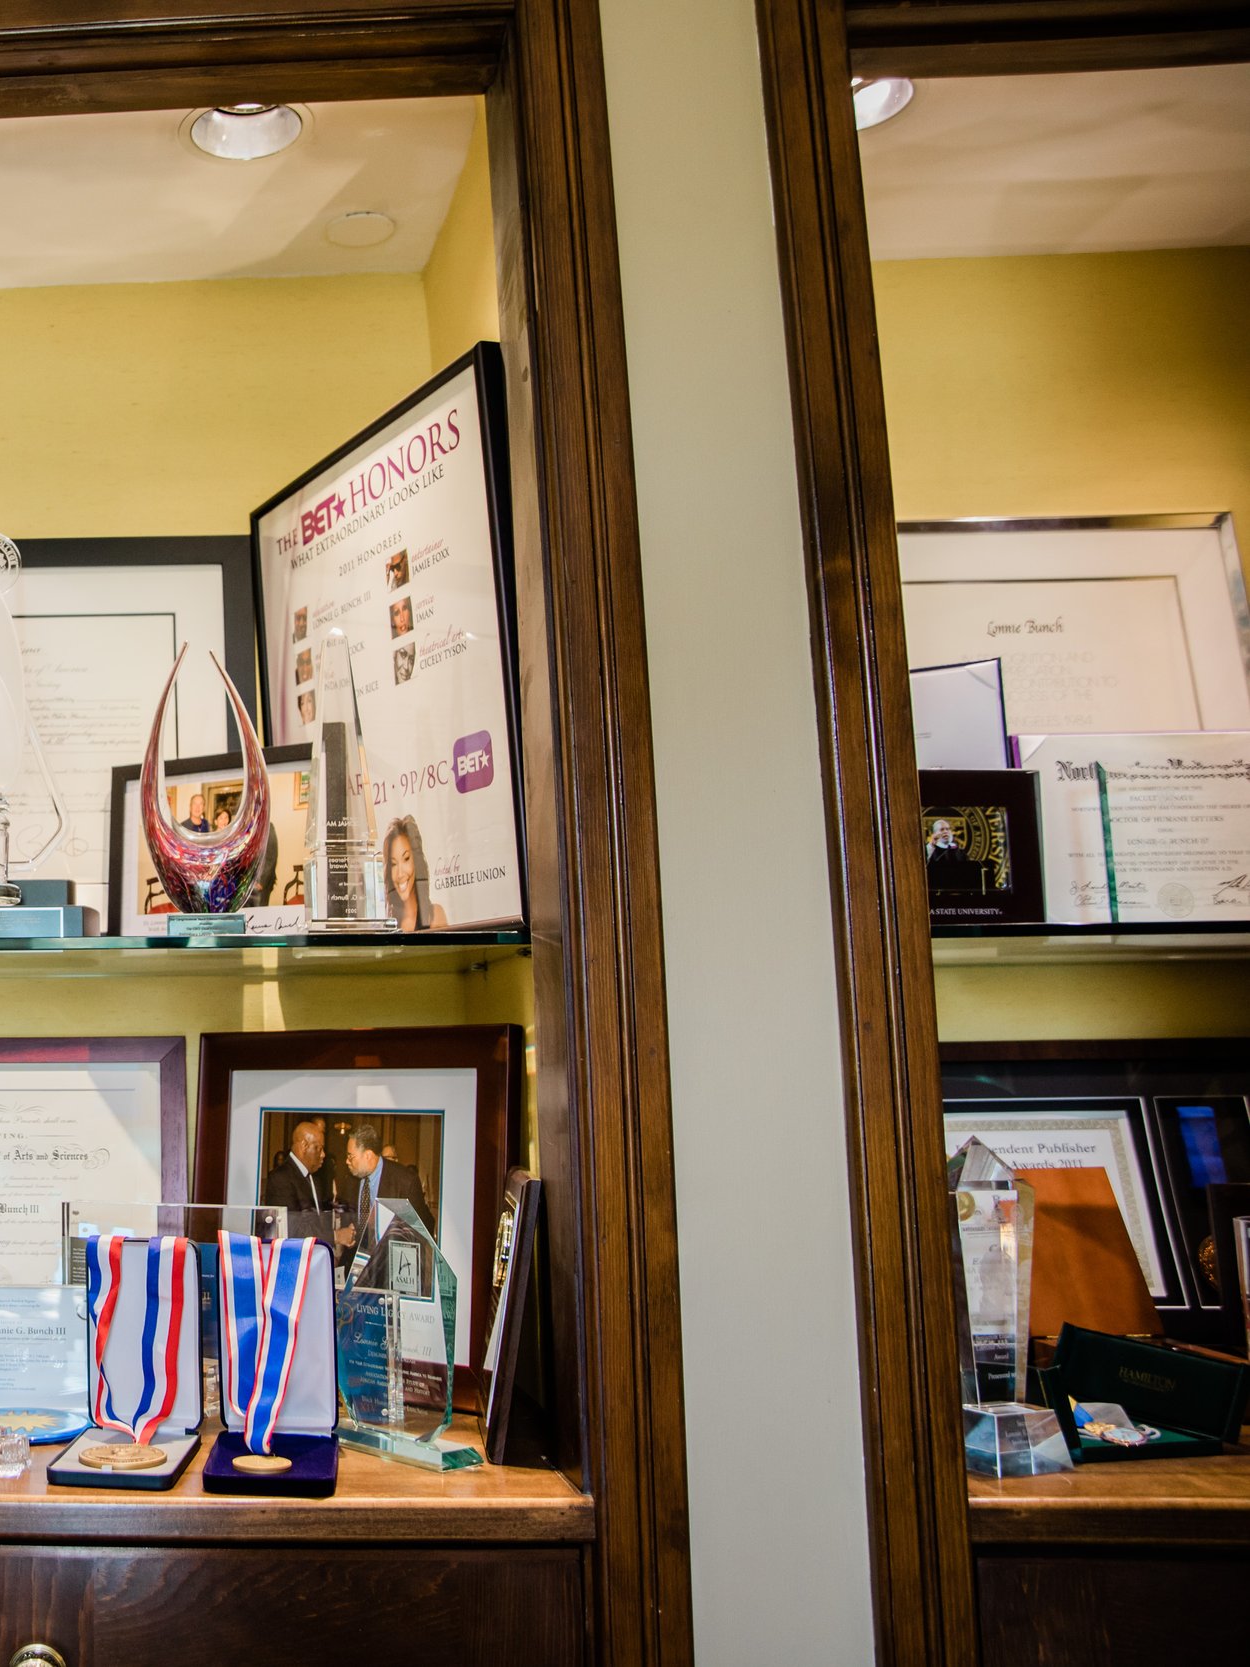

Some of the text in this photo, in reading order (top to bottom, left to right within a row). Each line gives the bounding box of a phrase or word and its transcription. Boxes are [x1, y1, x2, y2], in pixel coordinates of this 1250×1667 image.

[276, 408, 461, 555] THE BET HONORS
[290, 463, 445, 570] WHAT EXTRAORDINARY LOOKS LIKE
[338, 530, 403, 577] 2011 HONOREES
[412, 547, 451, 577] JAMIE FOXX
[312, 612, 333, 630] LONNIE
[416, 606, 435, 623] IMAN
[986, 615, 1065, 637] Lonnie Bunch
[419, 640, 467, 670] CICELY TYSON
[456, 752, 481, 778] BET
[373, 780, 388, 806] 21
[399, 759, 449, 799] 9P/8C
[434, 865, 507, 891] GABRIELLE UNION
[2, 1152, 11, 1161] of
[13, 1149, 33, 1161] Arts
[35, 1152, 49, 1161] and
[51, 1149, 89, 1161] Sciences
[1037, 1142, 1096, 1154] Publisher
[1011, 1160, 1055, 1169] Awards
[29, 1203, 40, 1215] III
[356, 1303, 436, 1325] LIVING AWARD
[15, 1326, 26, 1335] G.
[27, 1325, 55, 1336] Bunch
[55, 1326, 67, 1336] III
[352, 1331, 379, 1348] Lonnie
[1117, 1366, 1177, 1389] HAMILTON
